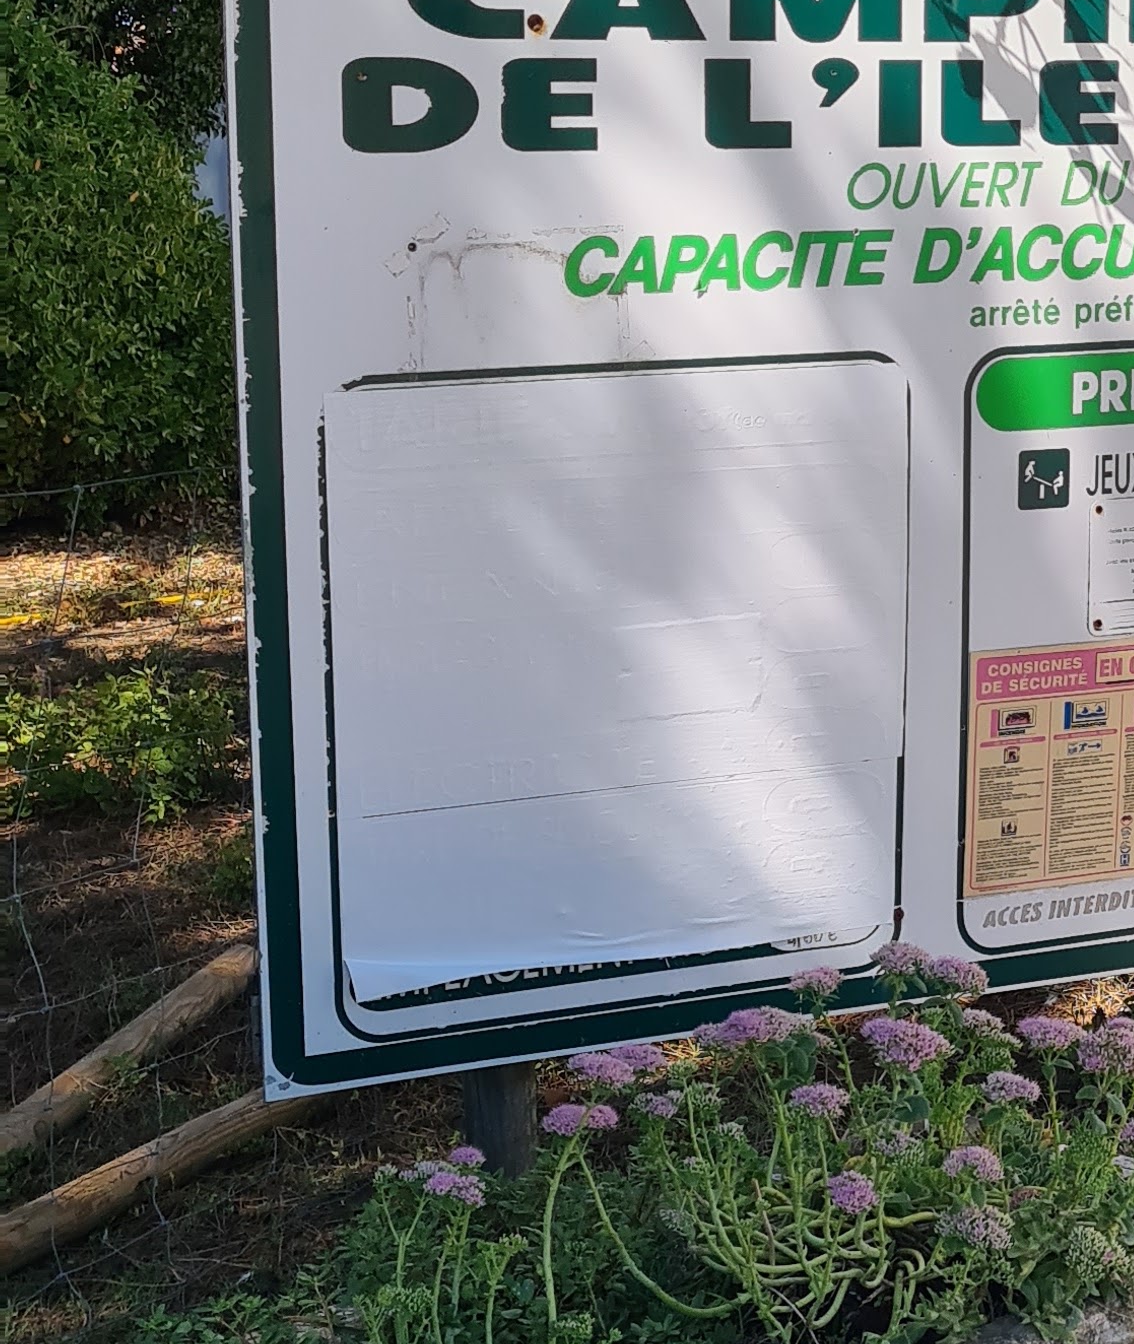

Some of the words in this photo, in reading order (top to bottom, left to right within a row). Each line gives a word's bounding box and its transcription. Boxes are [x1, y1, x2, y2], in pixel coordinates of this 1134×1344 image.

[342, 57, 598, 153] DE
[704, 58, 1119, 149] L'ILE
[847, 161, 1043, 210] OUVERT
[1061, 158, 1129, 206] DU
[565, 229, 895, 299] CAPACITE
[970, 297, 1061, 327] arrêté
[988, 657, 1083, 677] CONSIGNES
[1099, 657, 1124, 678] EN
[981, 681, 1003, 695] DE
[1008, 669, 1088, 692] SÉCURITÉ
[982, 901, 1044, 929] ACCES
